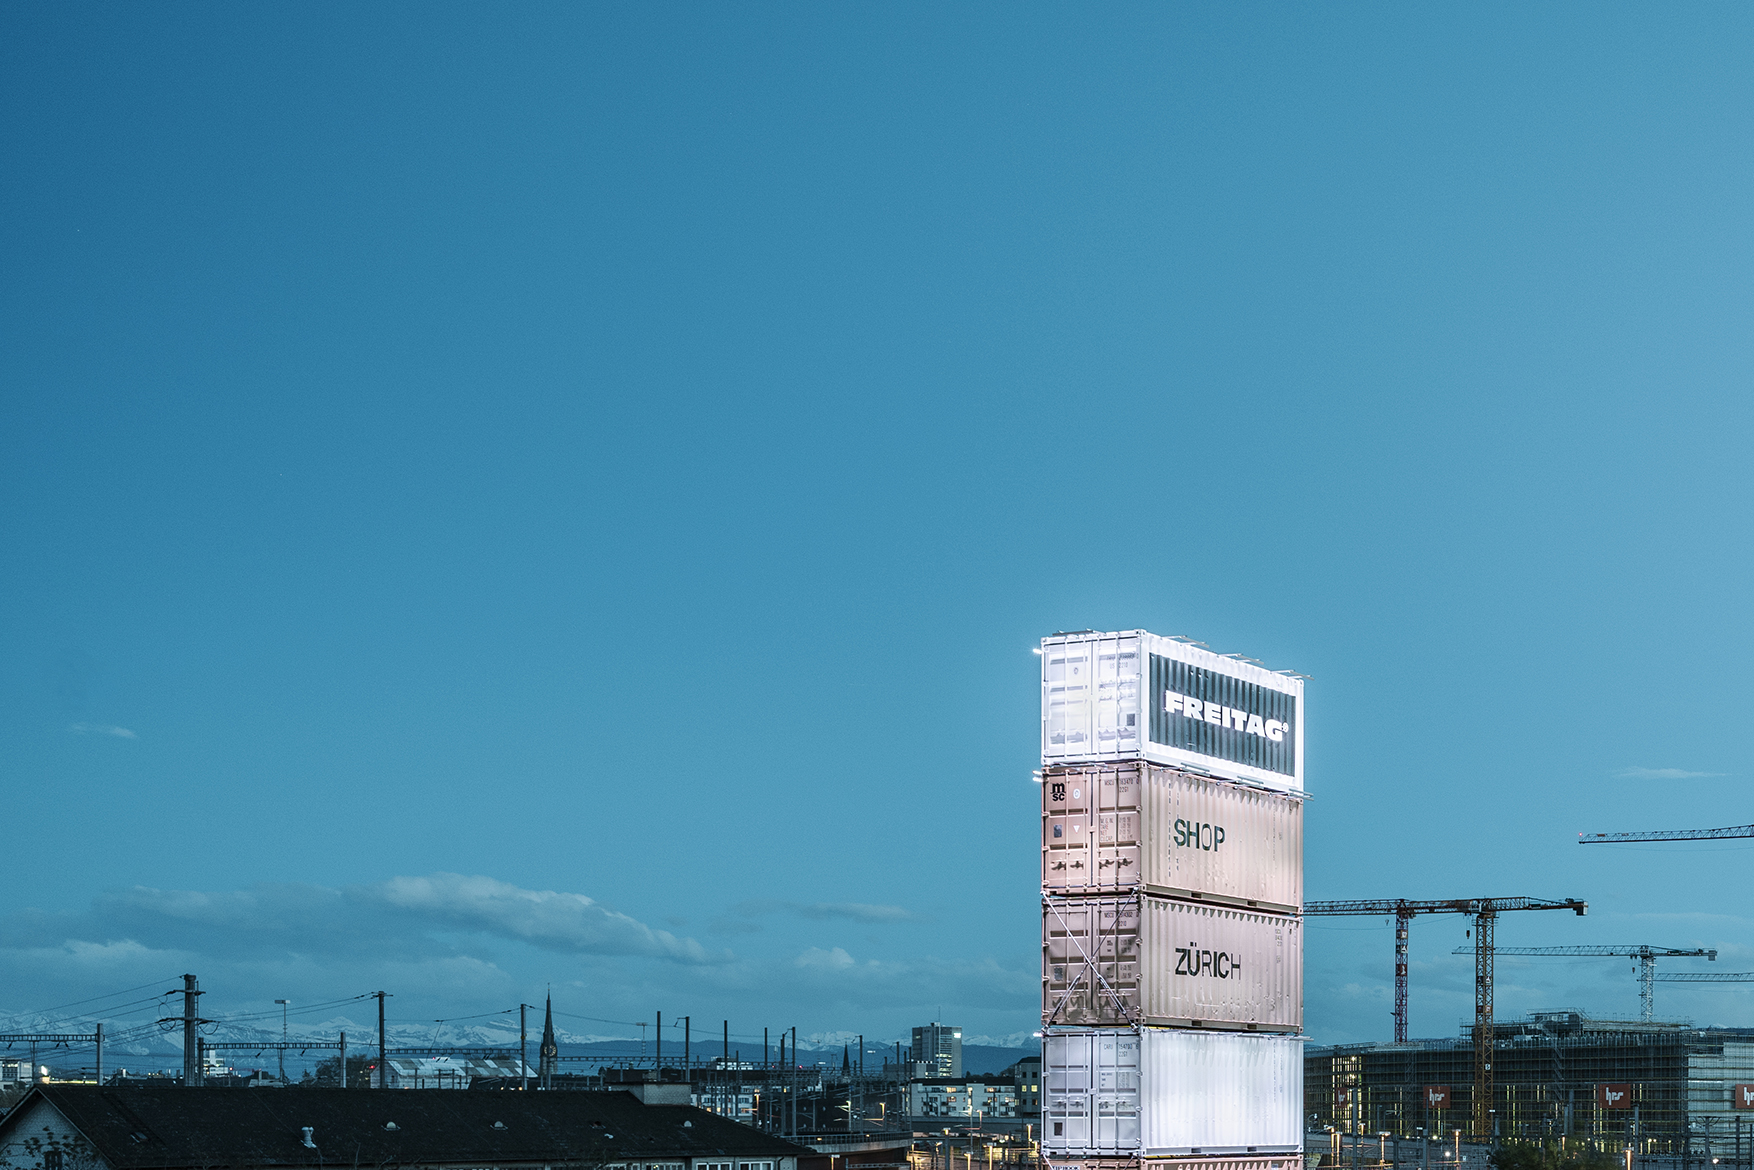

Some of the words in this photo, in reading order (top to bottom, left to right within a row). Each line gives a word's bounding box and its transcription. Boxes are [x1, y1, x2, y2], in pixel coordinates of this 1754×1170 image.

[1165, 689, 1283, 742] FREITAG
[1173, 818, 1226, 852] SHOP
[1175, 941, 1241, 980] ZÜRICH
[1605, 1086, 1623, 1106] hrs
